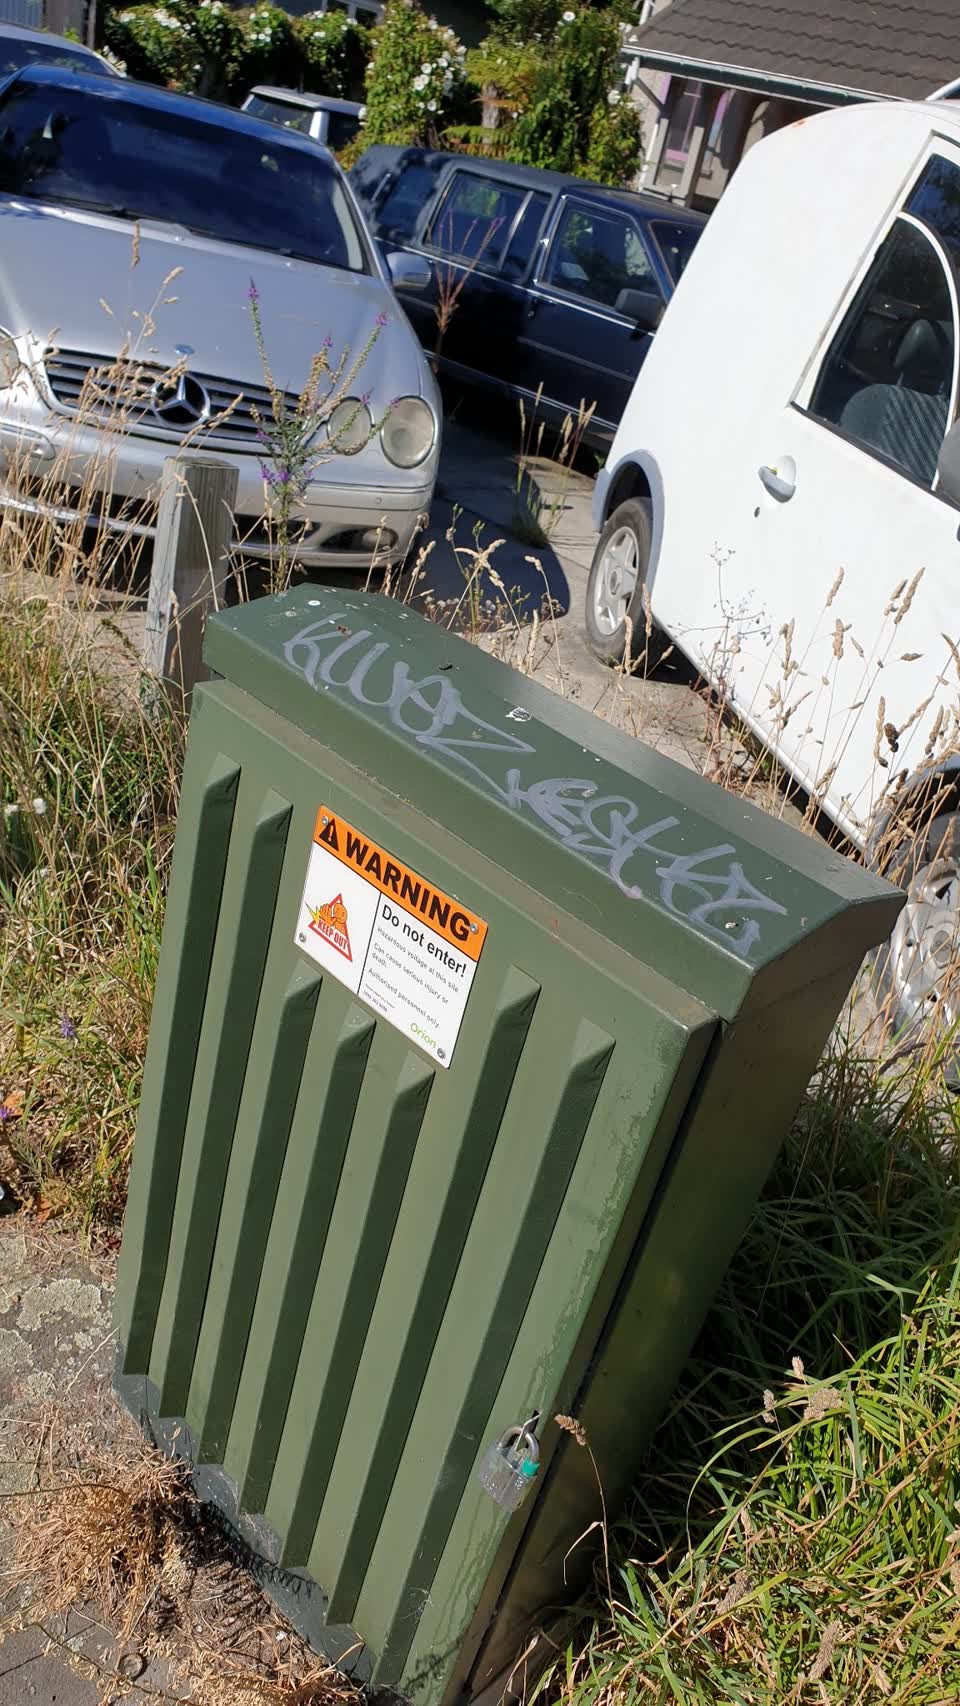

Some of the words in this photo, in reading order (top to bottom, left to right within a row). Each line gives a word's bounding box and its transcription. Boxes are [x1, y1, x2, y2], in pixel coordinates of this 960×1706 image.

[346, 831, 471, 942] WARNING
[317, 919, 334, 938] KEEP
[333, 932, 349, 950] OUT
[377, 927, 406, 953] Hazardous
[407, 951, 428, 970] voltage
[428, 967, 435, 976] at
[435, 971, 447, 984] this
[447, 981, 459, 993] site
[381, 903, 400, 928] Do
[402, 922, 425, 947] not
[426, 942, 467, 978] enter!
[367, 967, 398, 995] Authorised
[397, 991, 426, 1017] personnel
[373, 942, 385, 955] Can
[385, 953, 402, 969] cause
[403, 966, 424, 985] serious
[424, 983, 442, 1000] injury
[441, 996, 449, 1005] or
[410, 1022, 437, 1049] Orion
